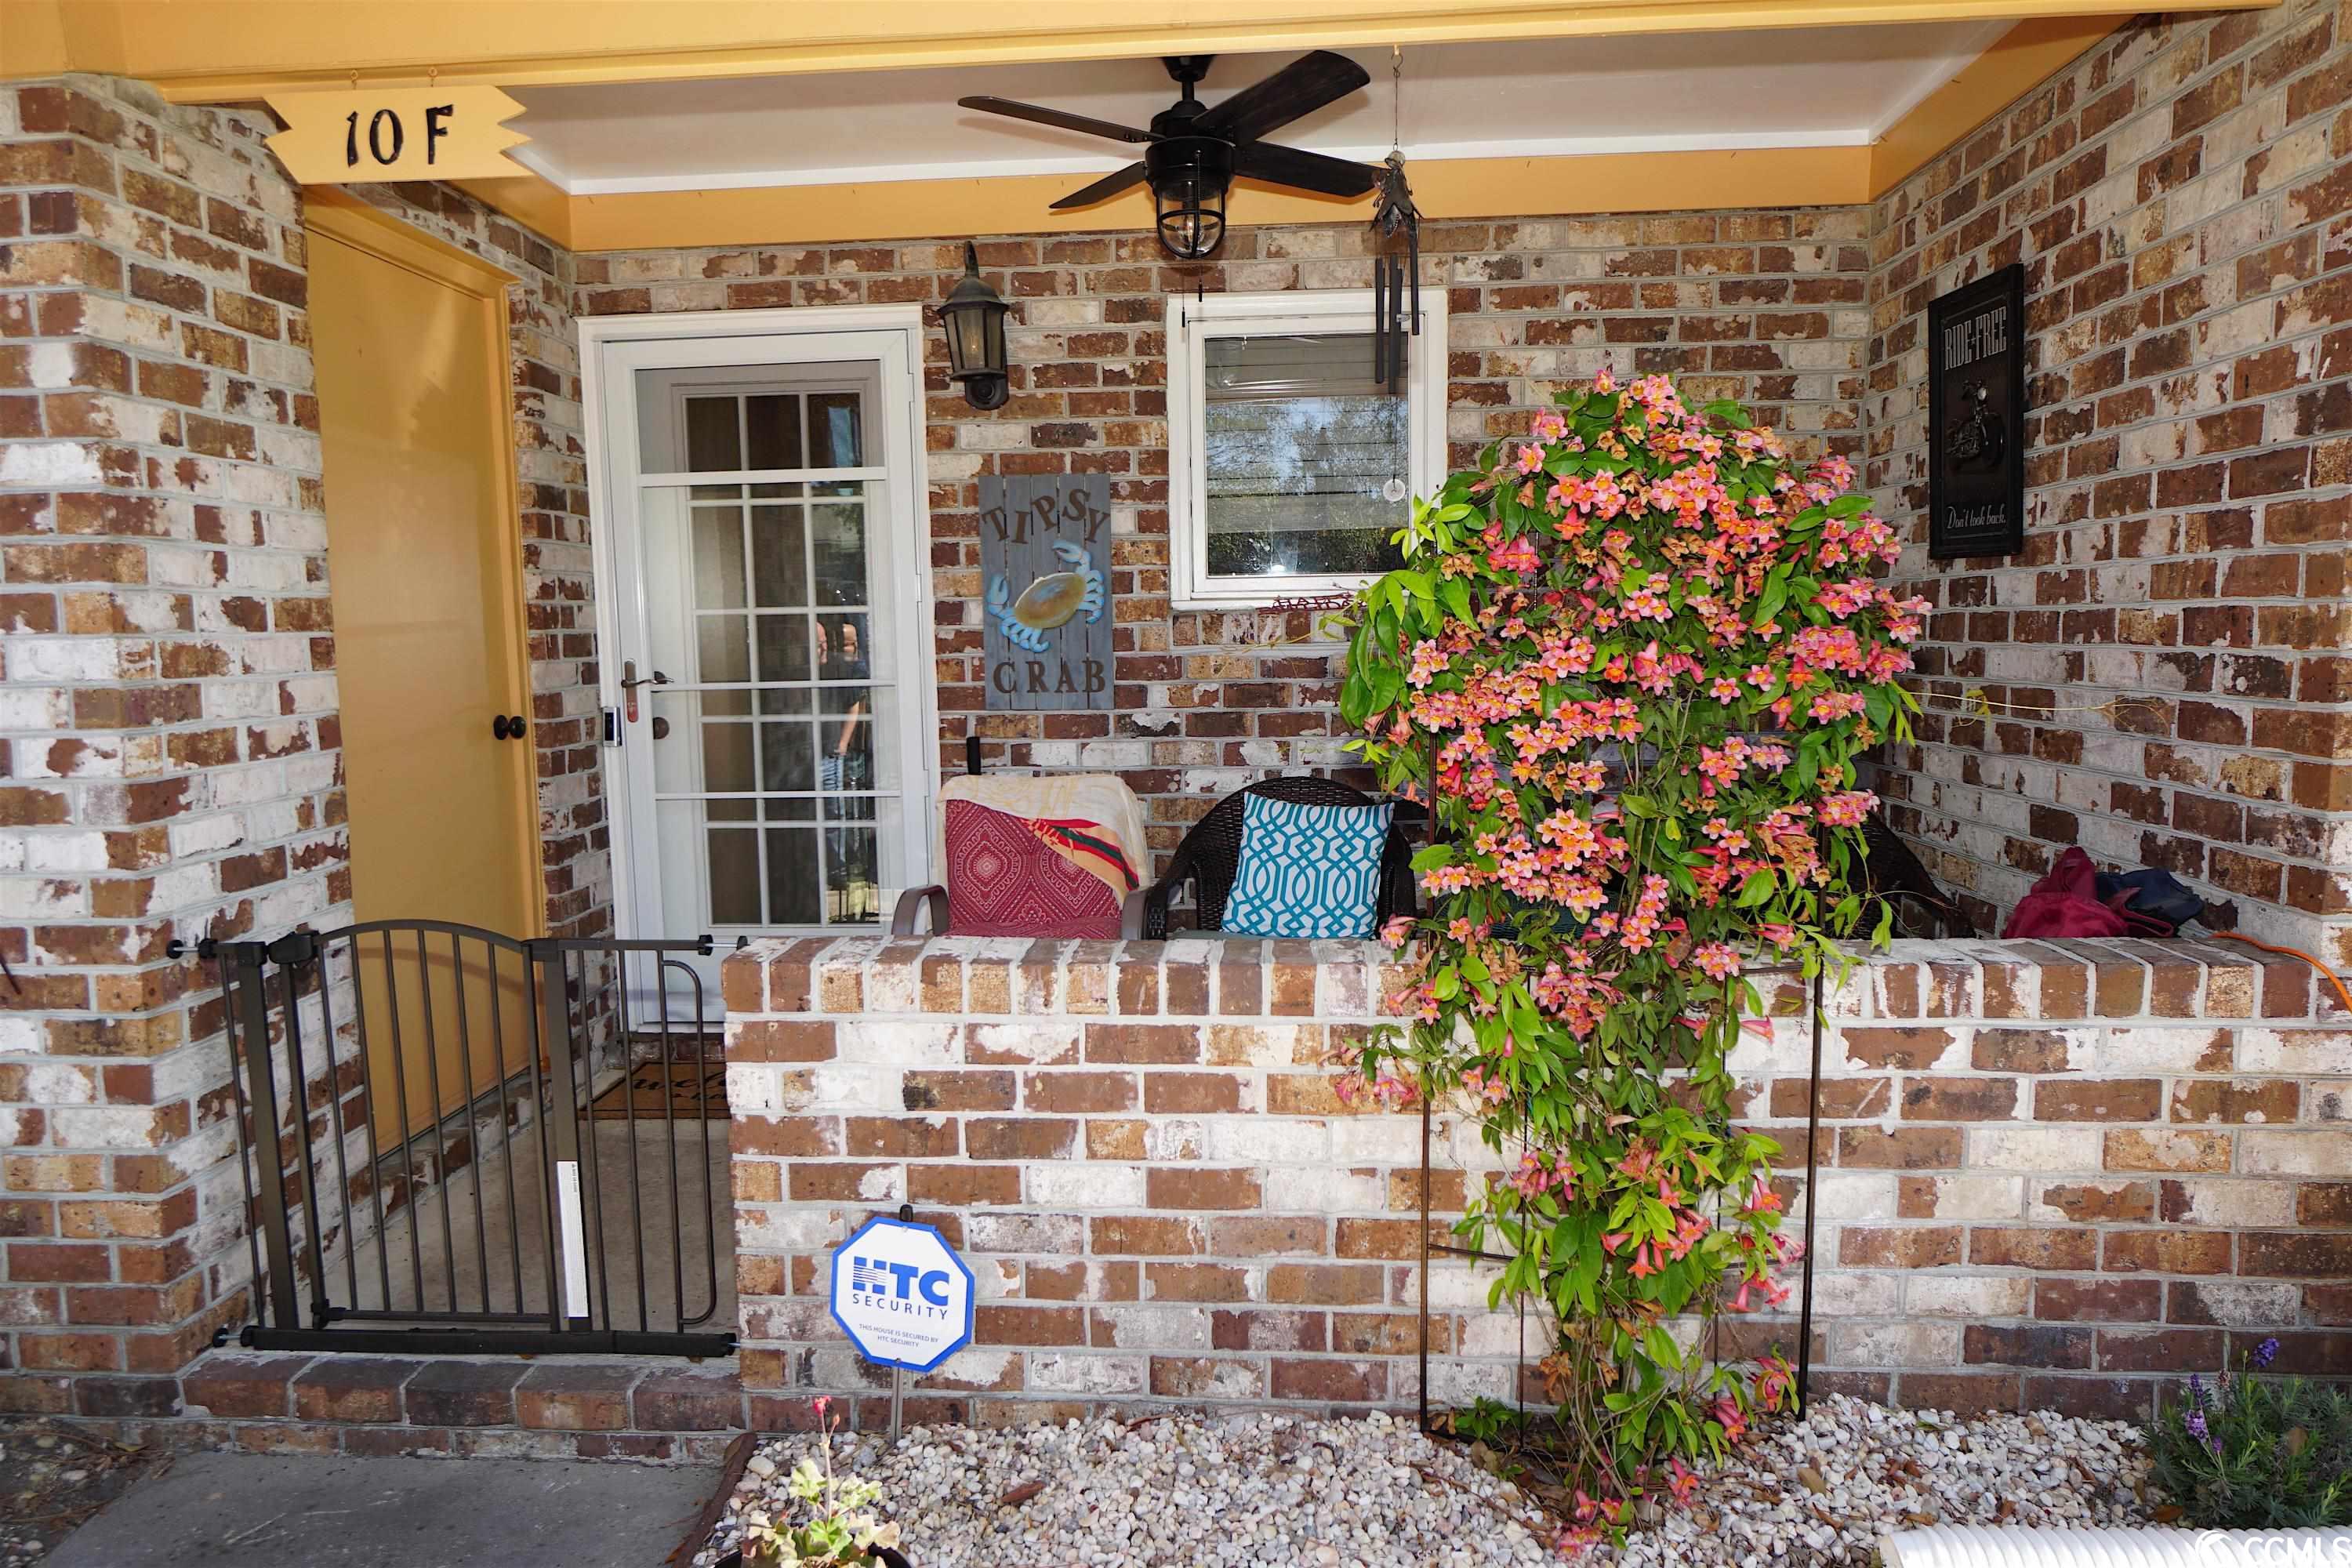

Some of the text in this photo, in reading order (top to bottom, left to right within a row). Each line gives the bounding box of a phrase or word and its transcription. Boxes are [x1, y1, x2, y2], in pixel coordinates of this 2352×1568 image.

[982, 488, 1111, 544] TIPSY
[1947, 506, 1969, 529] Don't
[1969, 506, 1986, 527] look
[992, 659, 1106, 695] CRAB
[852, 1255, 950, 1307] HTC
[852, 1293, 948, 1320] SECURITY
[873, 1326, 895, 1335] HOUSE
[902, 1330, 930, 1342] SECURED
[891, 1338, 920, 1348] SECURITY
